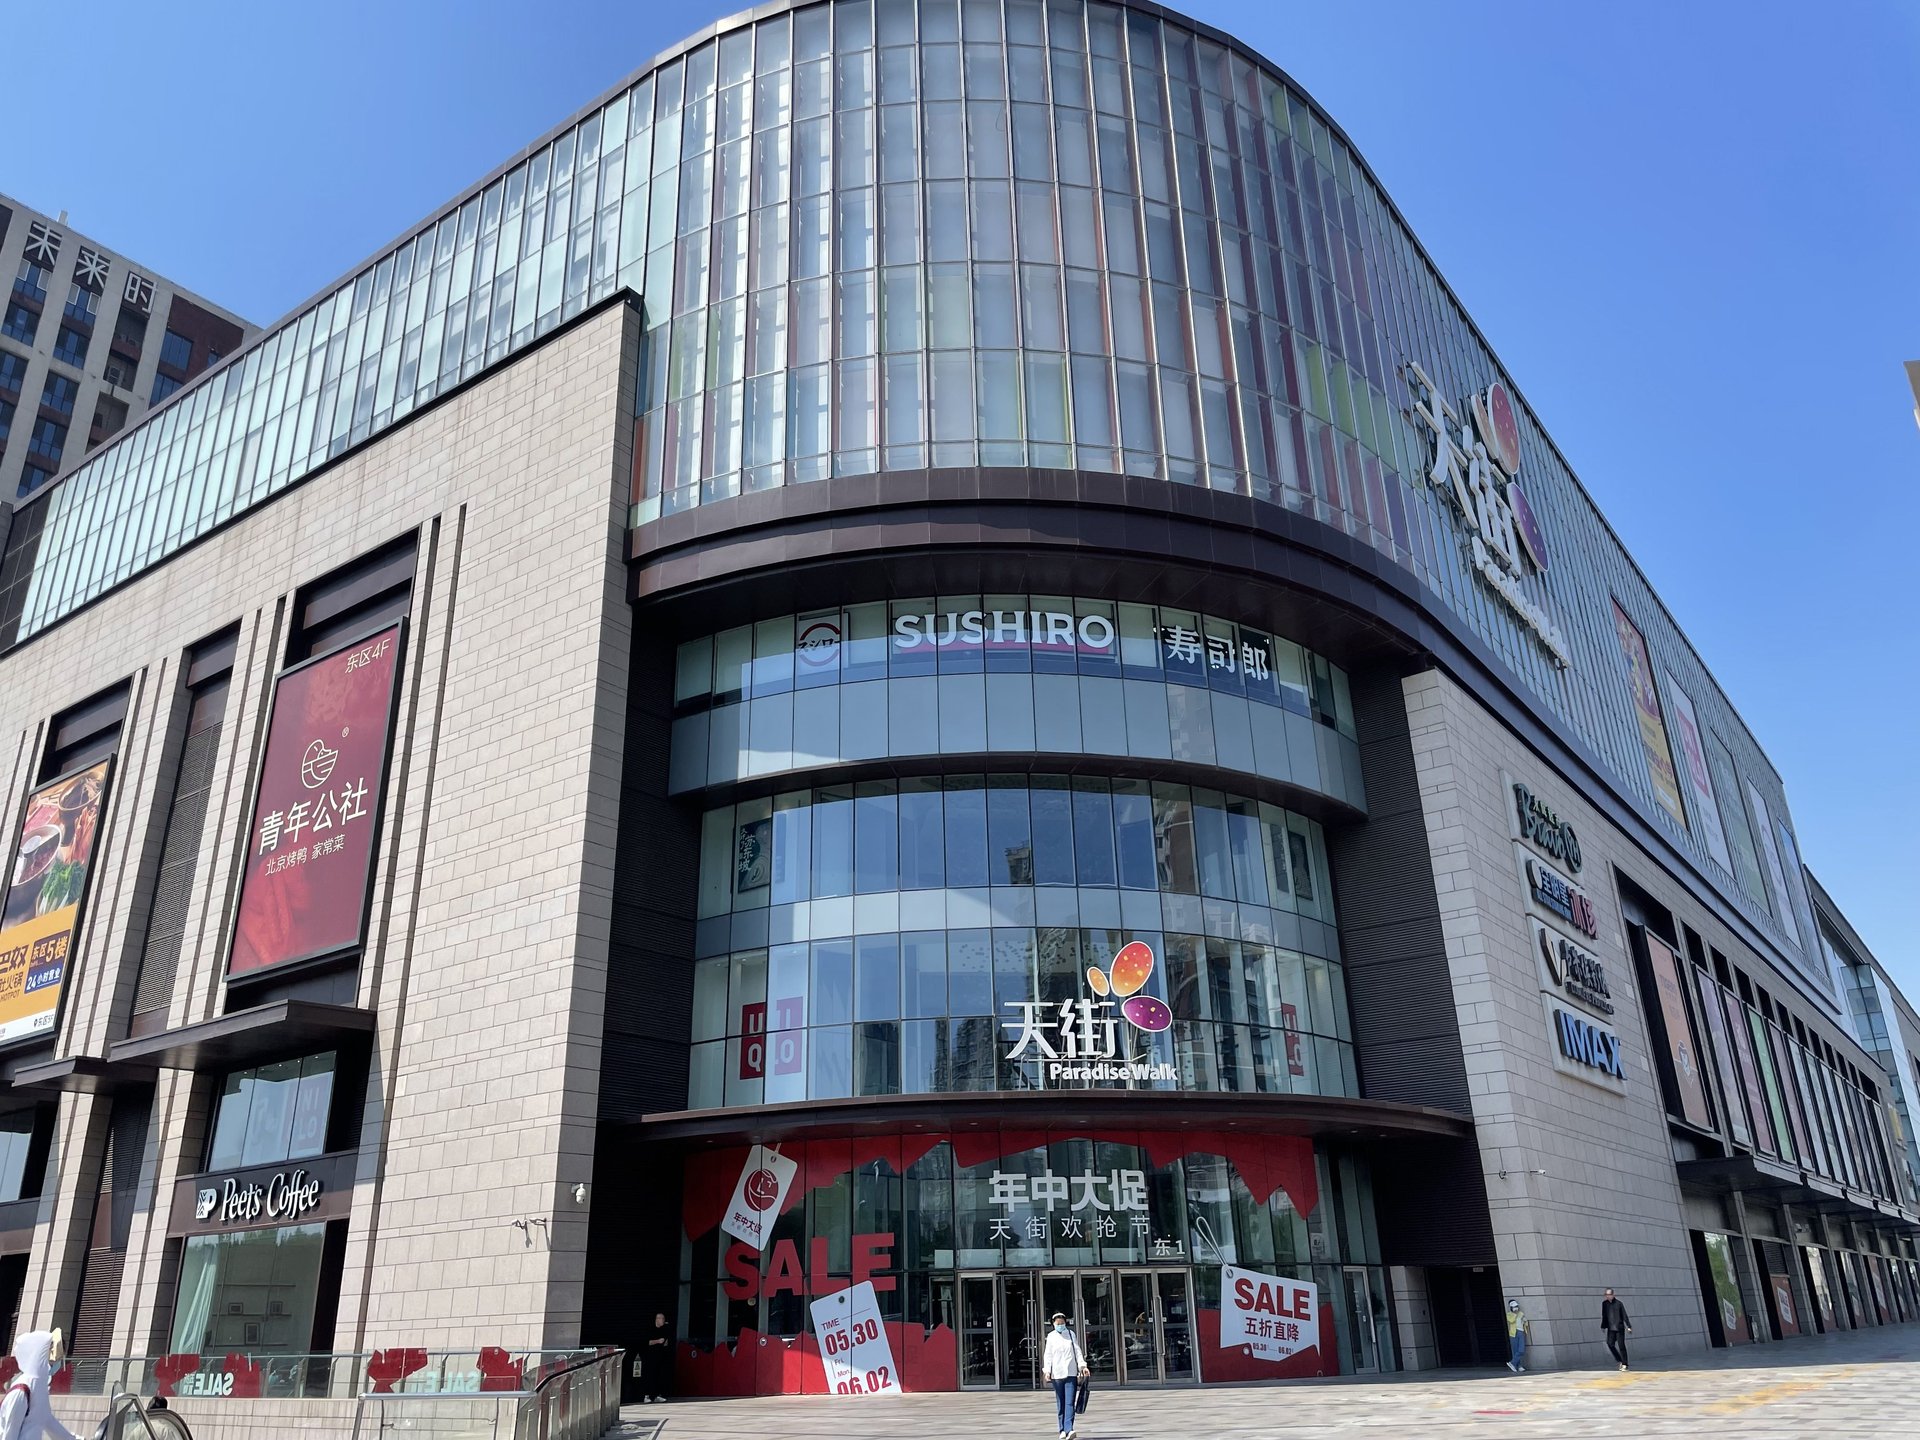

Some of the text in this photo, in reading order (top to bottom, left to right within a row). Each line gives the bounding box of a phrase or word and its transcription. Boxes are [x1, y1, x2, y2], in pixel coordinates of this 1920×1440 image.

[894, 610, 1115, 650] SUSHIRO
[344, 637, 392, 674] 东区4F
[1164, 625, 1270, 681] 寿司郎
[258, 776, 369, 856] 青年公社
[264, 833, 346, 876] 北京烤鸭 家常菜
[32, 935, 68, 963] 东区5楼
[1001, 998, 1119, 1060] 天街
[1555, 1009, 1627, 1080] IMAX
[1050, 1063, 1178, 1080] Paradise Walk
[219, 1169, 319, 1221] Peet's Coffee
[988, 1168, 1149, 1212] 年中大促
[989, 1215, 1150, 1241] 天街欢抢节
[723, 1232, 897, 1300] SALE
[1234, 1278, 1311, 1321] SALE
[821, 1318, 840, 1331] TIME
[825, 1318, 879, 1356] 05.30
[1245, 1316, 1299, 1342] 五折直降
